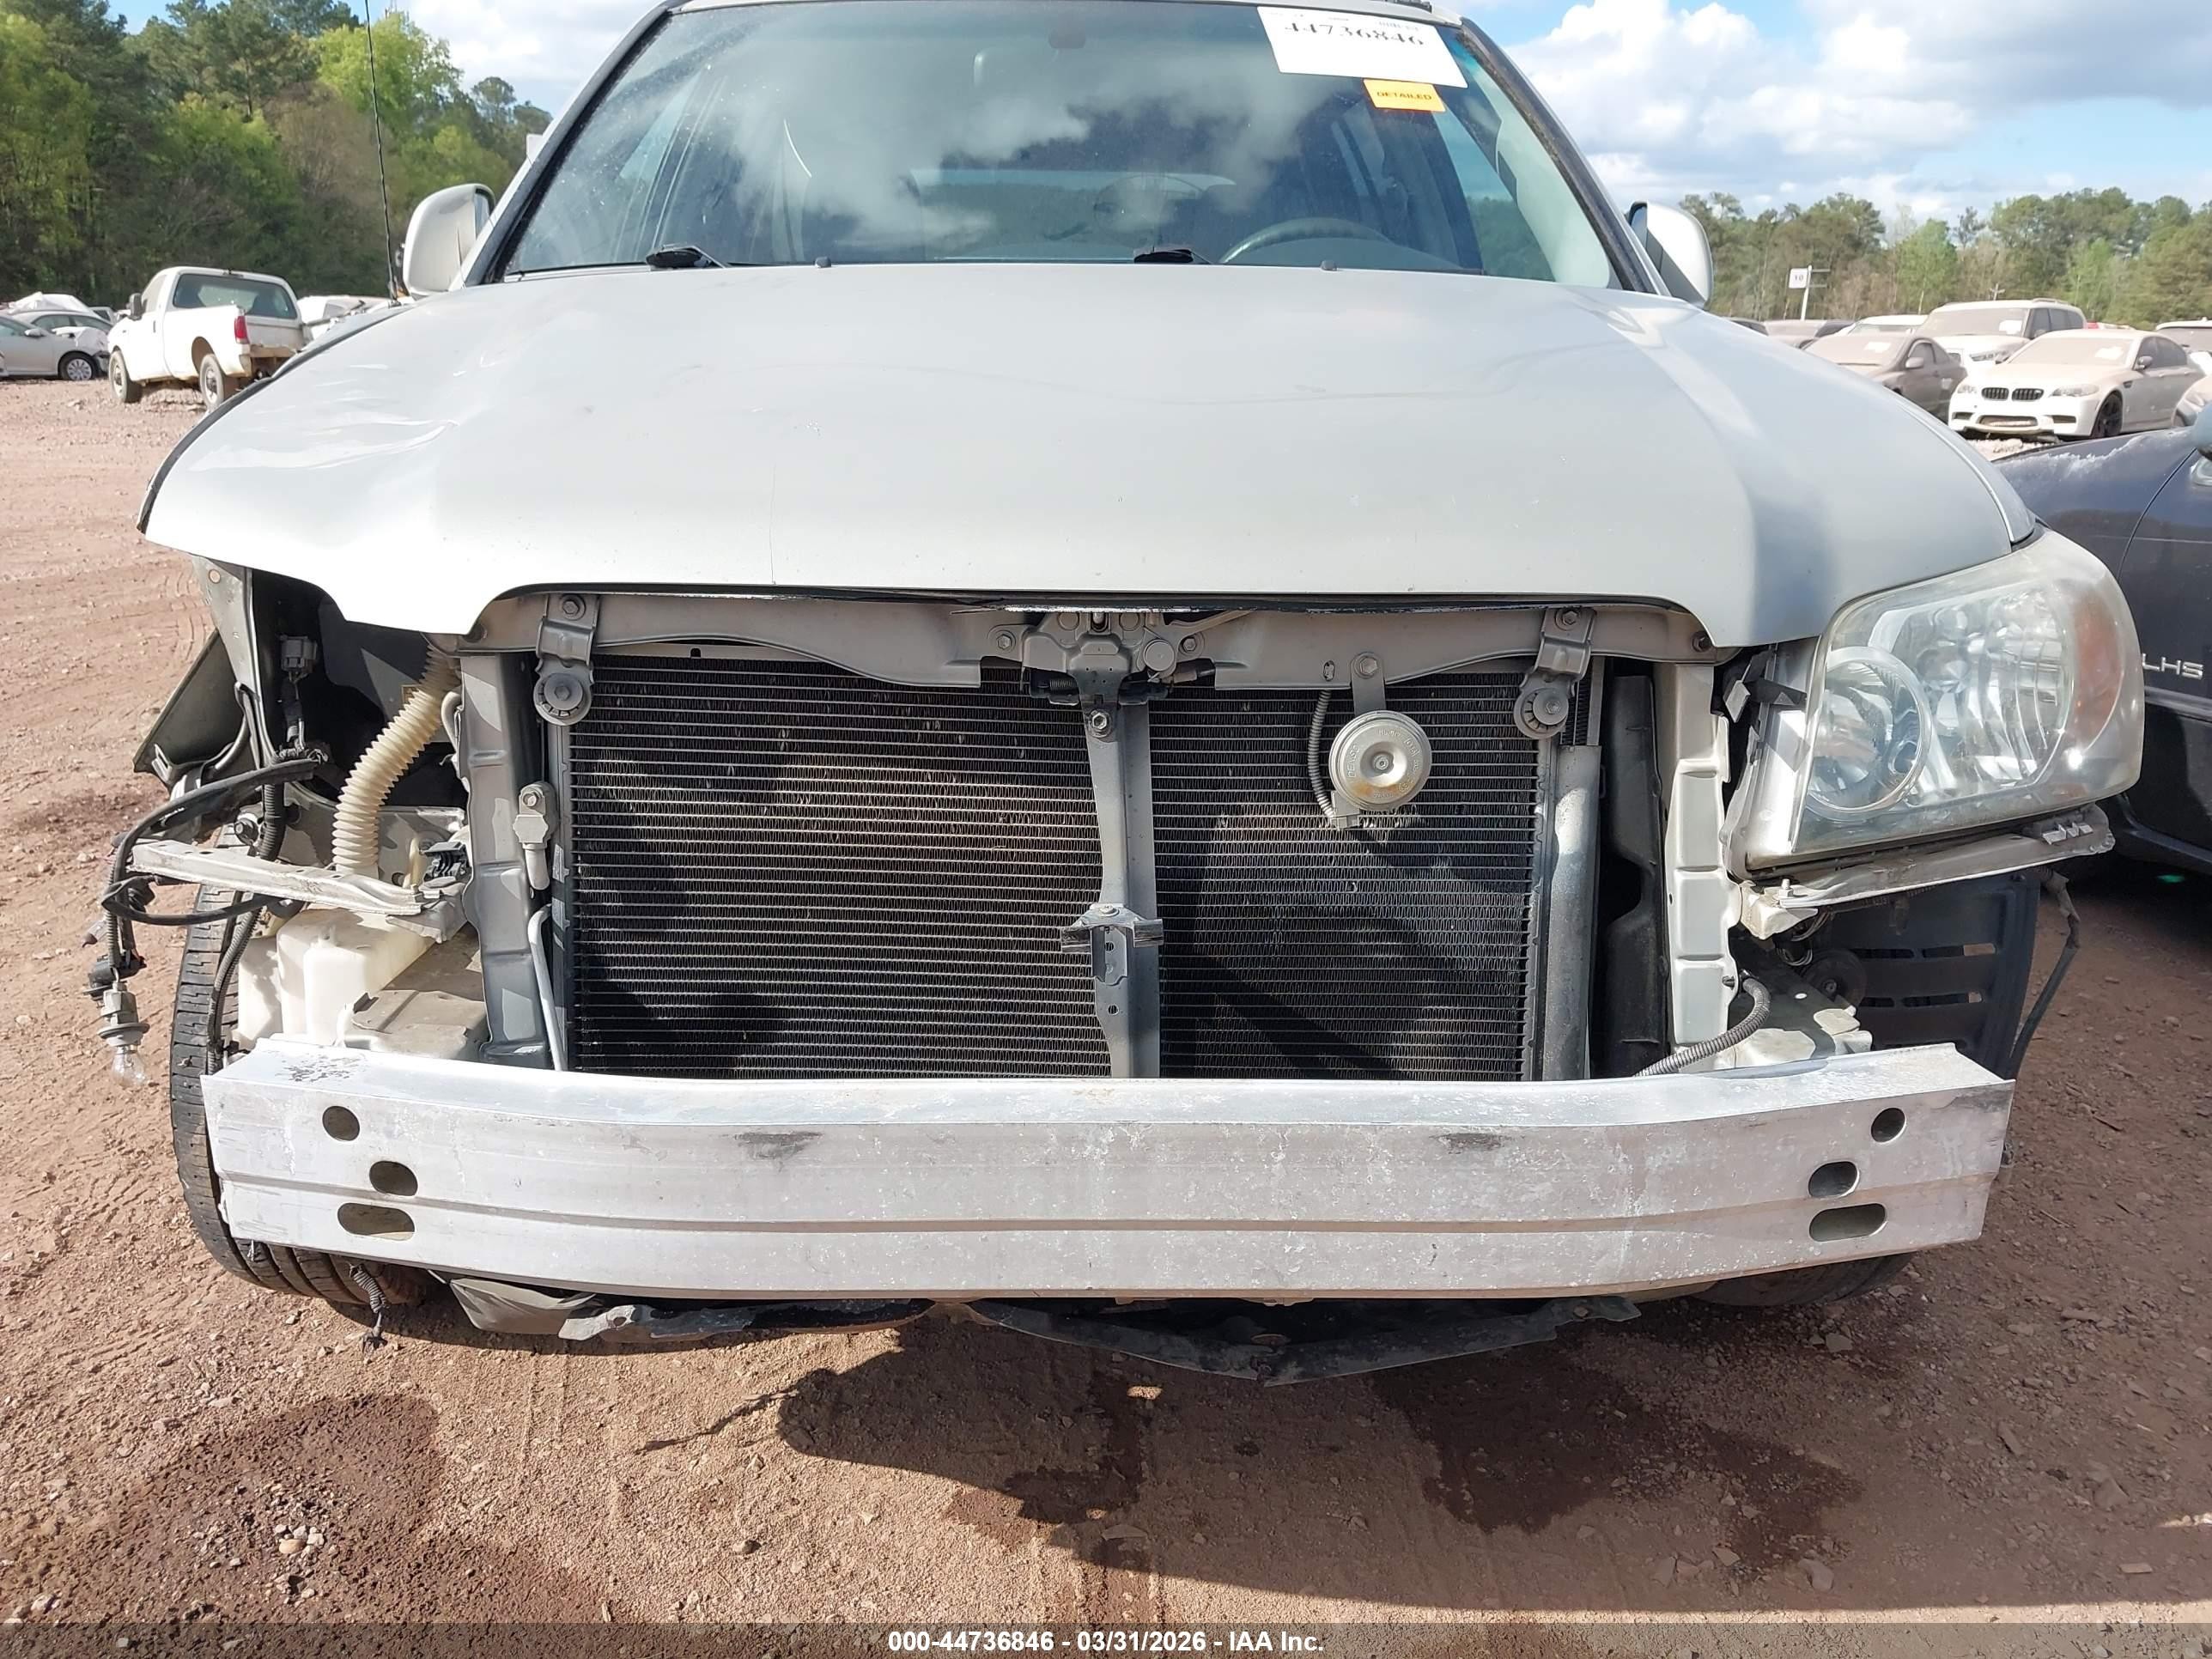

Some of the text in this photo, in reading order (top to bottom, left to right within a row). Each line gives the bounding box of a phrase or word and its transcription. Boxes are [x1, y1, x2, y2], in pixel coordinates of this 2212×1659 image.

[1285, 21, 1425, 46] 44736846
[1376, 90, 1433, 101] DETAILED
[2142, 653, 2204, 680] LHS
